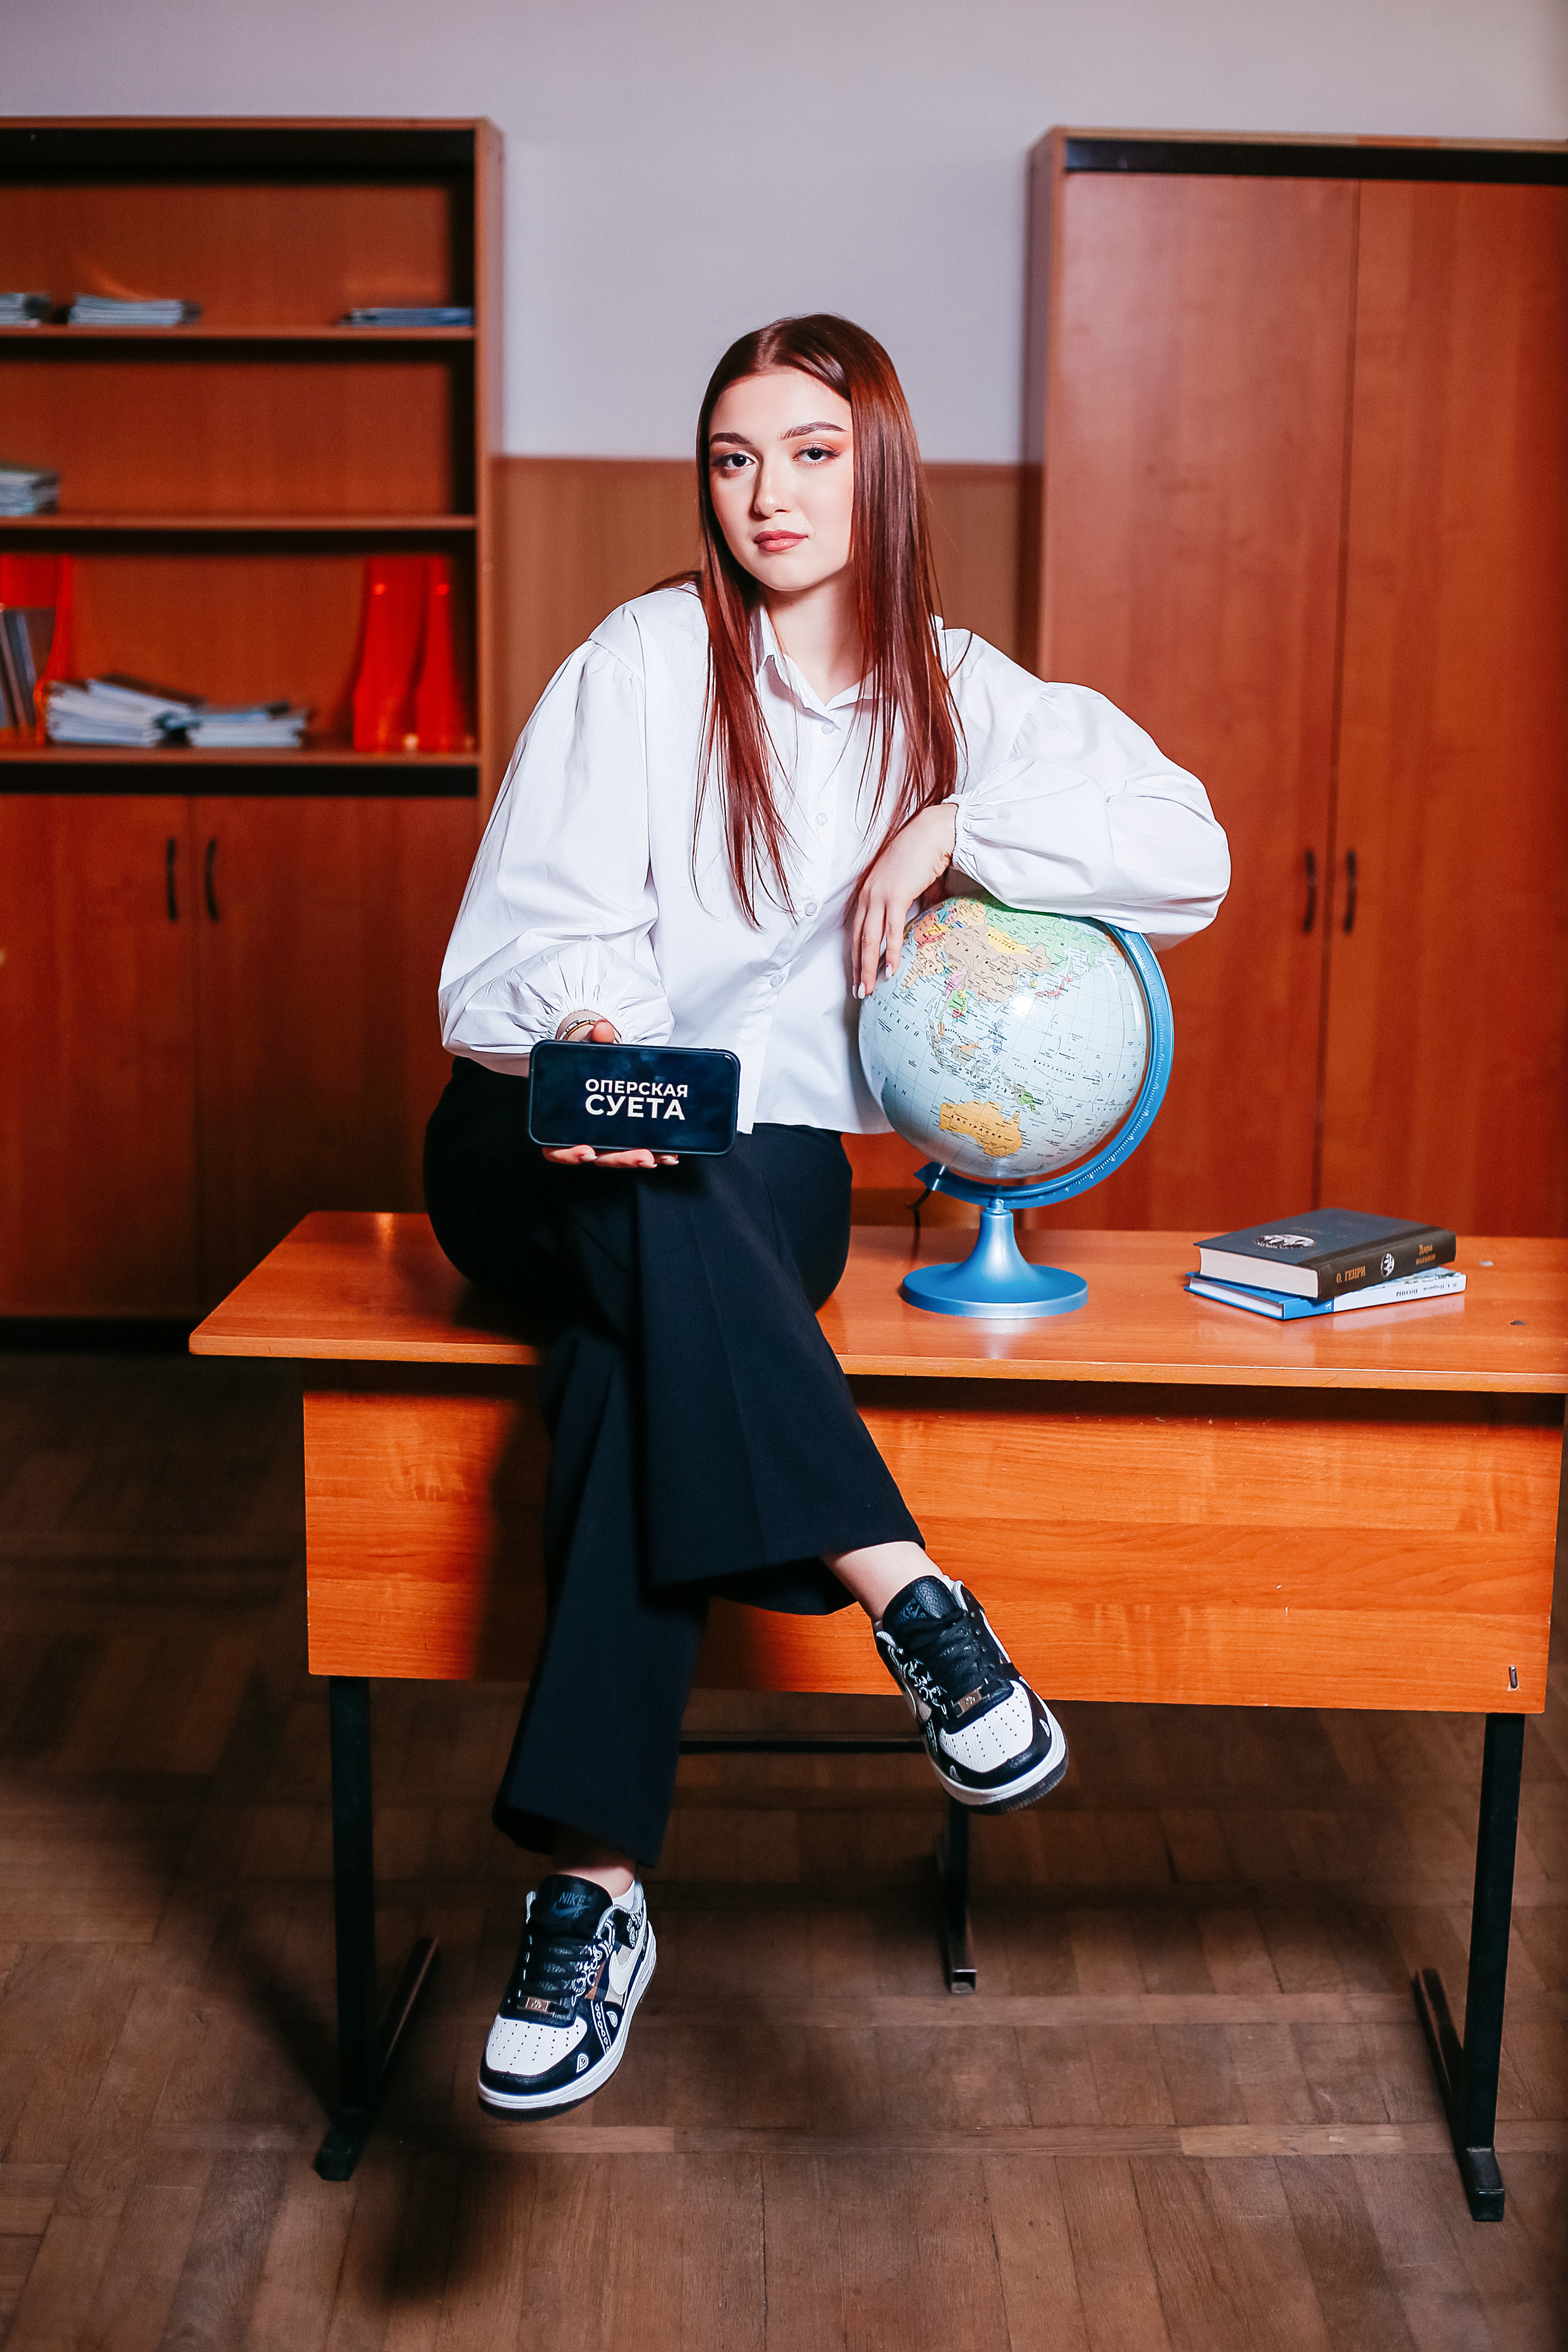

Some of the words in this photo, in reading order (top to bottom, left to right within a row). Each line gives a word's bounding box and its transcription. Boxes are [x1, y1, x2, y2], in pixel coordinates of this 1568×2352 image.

[585, 1079, 688, 1098] ОПЕРСКАЯ
[585, 1094, 685, 1120] СУЕТА
[950, 1114, 1002, 1139] АВСТРАЛИЯ
[1336, 1273, 1343, 1284] О.
[1344, 1265, 1366, 1281] ГЕНРИ
[559, 1891, 586, 1907] NIKE
